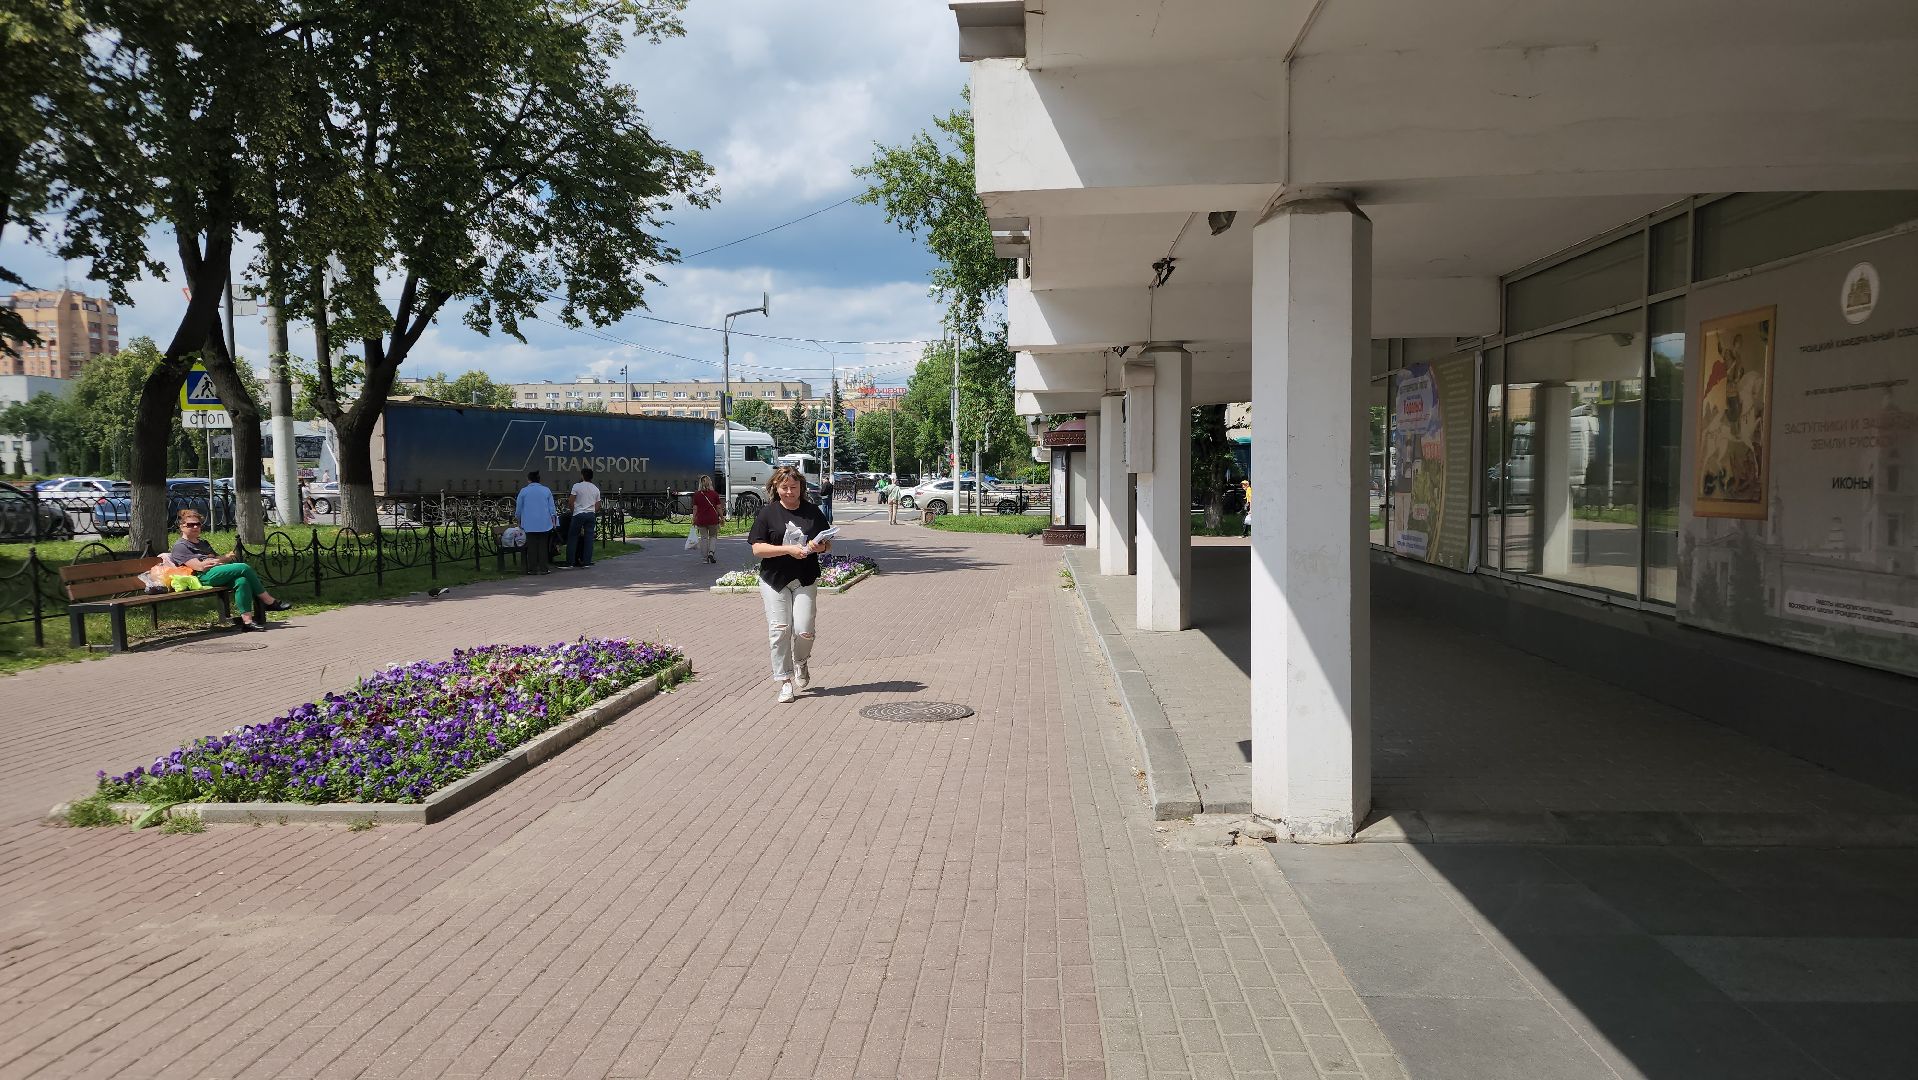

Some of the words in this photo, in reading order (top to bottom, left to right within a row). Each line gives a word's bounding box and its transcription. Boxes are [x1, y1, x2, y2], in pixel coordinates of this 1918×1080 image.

[190, 413, 225, 425] СТОП
[544, 434, 594, 453] DFDS
[544, 455, 650, 472] TRANSPORT
[1832, 476, 1873, 489] ИКОНЫ
